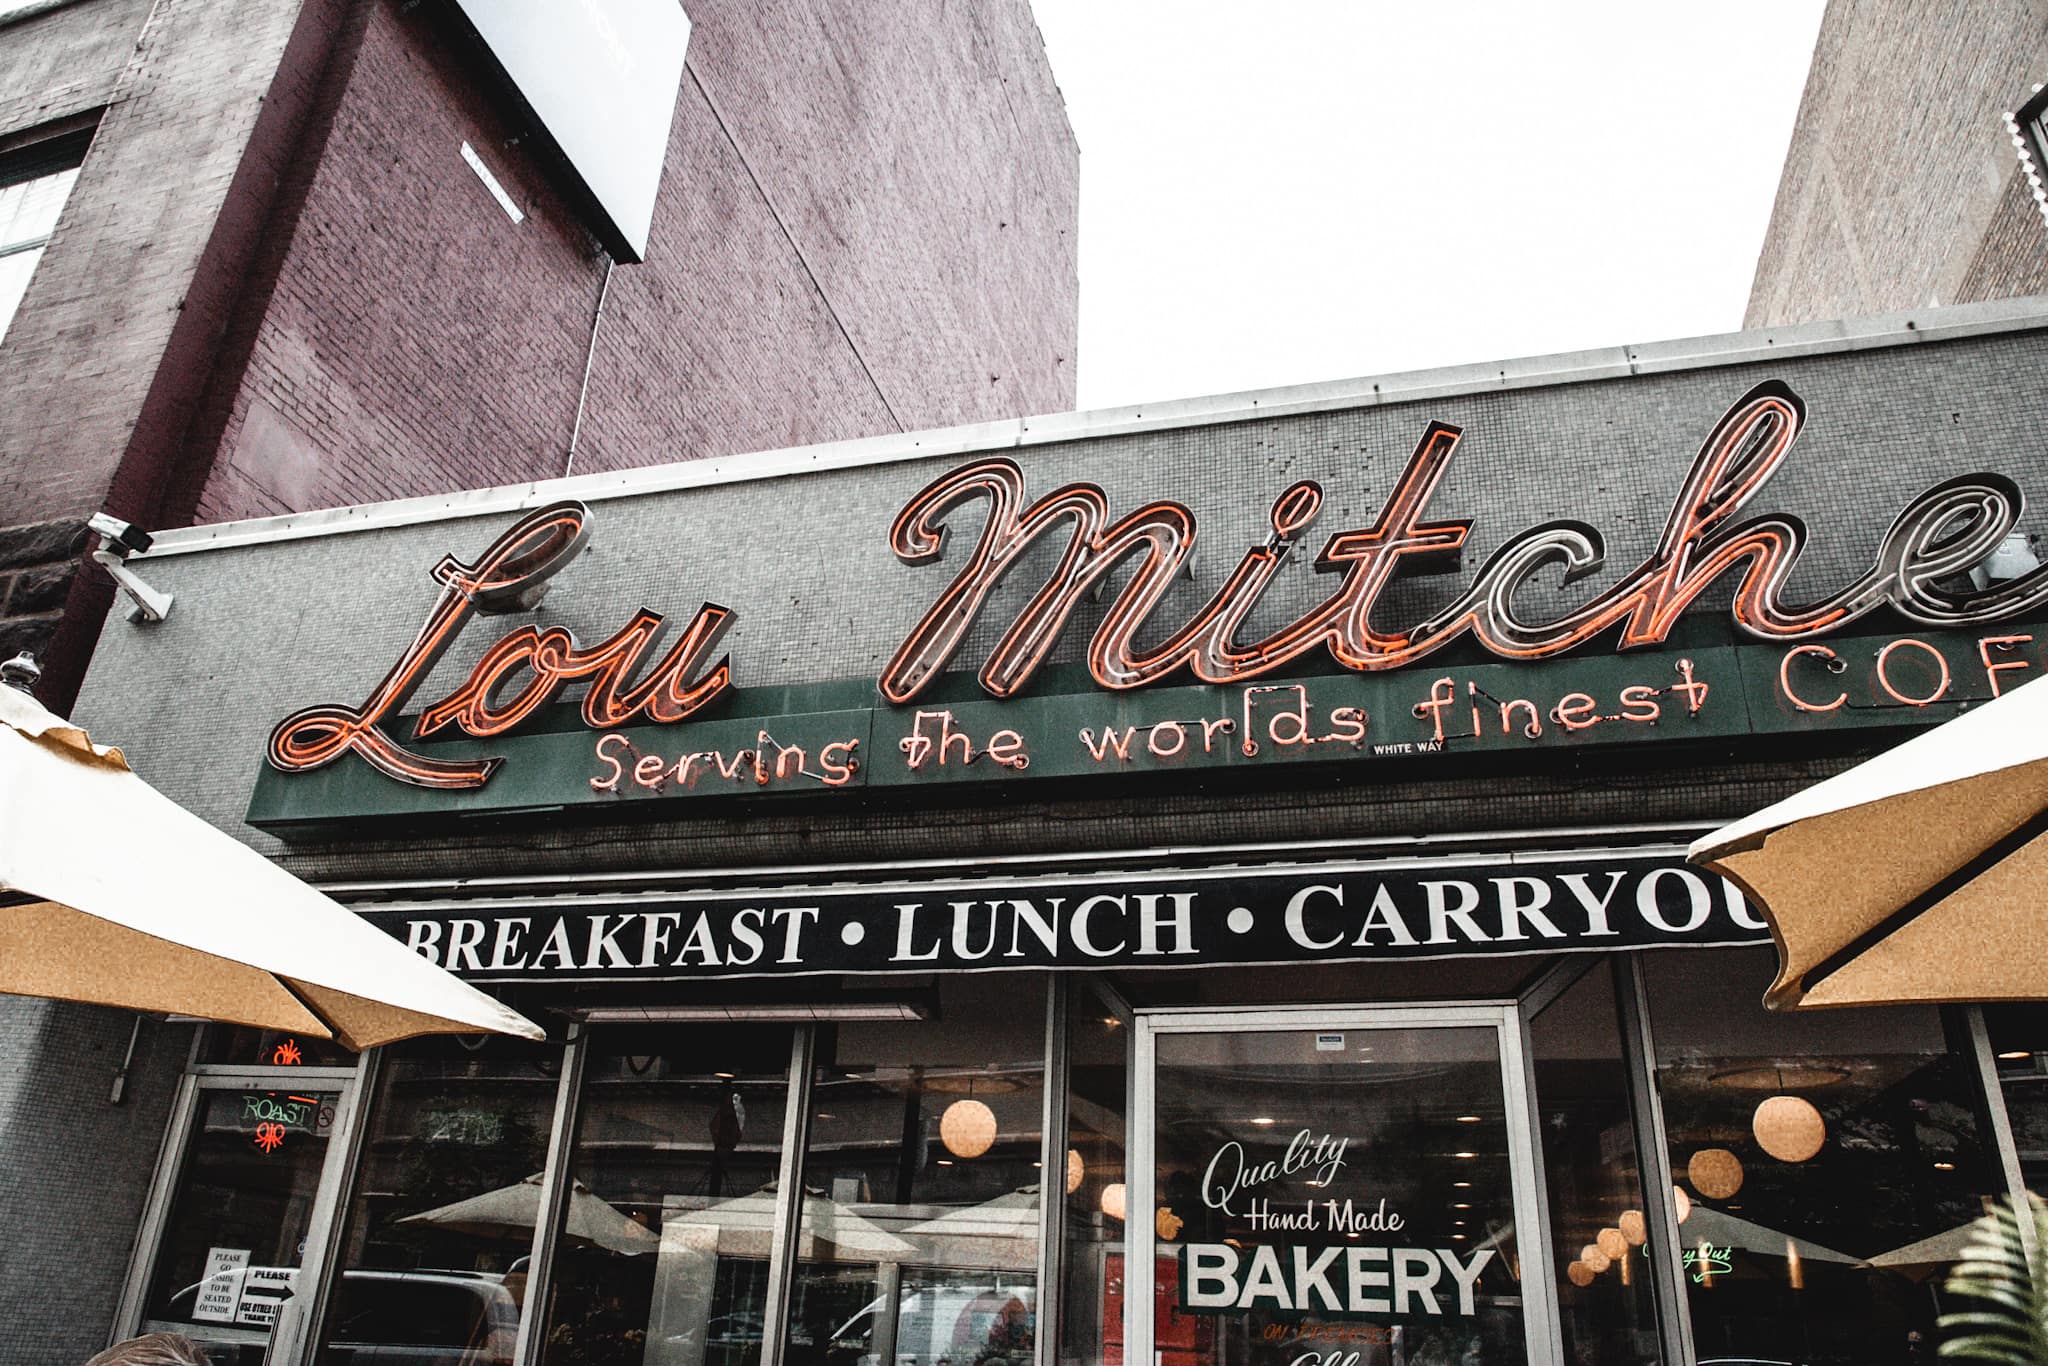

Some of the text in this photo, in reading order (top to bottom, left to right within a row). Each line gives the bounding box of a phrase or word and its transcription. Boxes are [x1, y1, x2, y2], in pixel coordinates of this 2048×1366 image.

[267, 500, 738, 788] Lou
[590, 730, 859, 788] Serving
[900, 710, 1030, 770] the
[1080, 684, 1368, 757] worlds
[1412, 658, 1708, 740] finest
[1374, 741, 1443, 755] WHITE WAY
[888, 892, 1200, 962] LUNCH
[241, 1095, 311, 1127] ROAST
[1201, 1128, 1349, 1216] Quality
[1243, 1198, 1404, 1232] Hand Made
[215, 1253, 241, 1262] PLEASE
[220, 1264, 231, 1272] GO
[254, 1270, 291, 1281] PLEASE
[1185, 1243, 1496, 1316] BAKERY
[210, 1284, 231, 1293] TO BE
[204, 1295, 231, 1303] SEATED
[199, 1304, 229, 1314] OUTSIDE
[1263, 1323, 1289, 1340] ON
